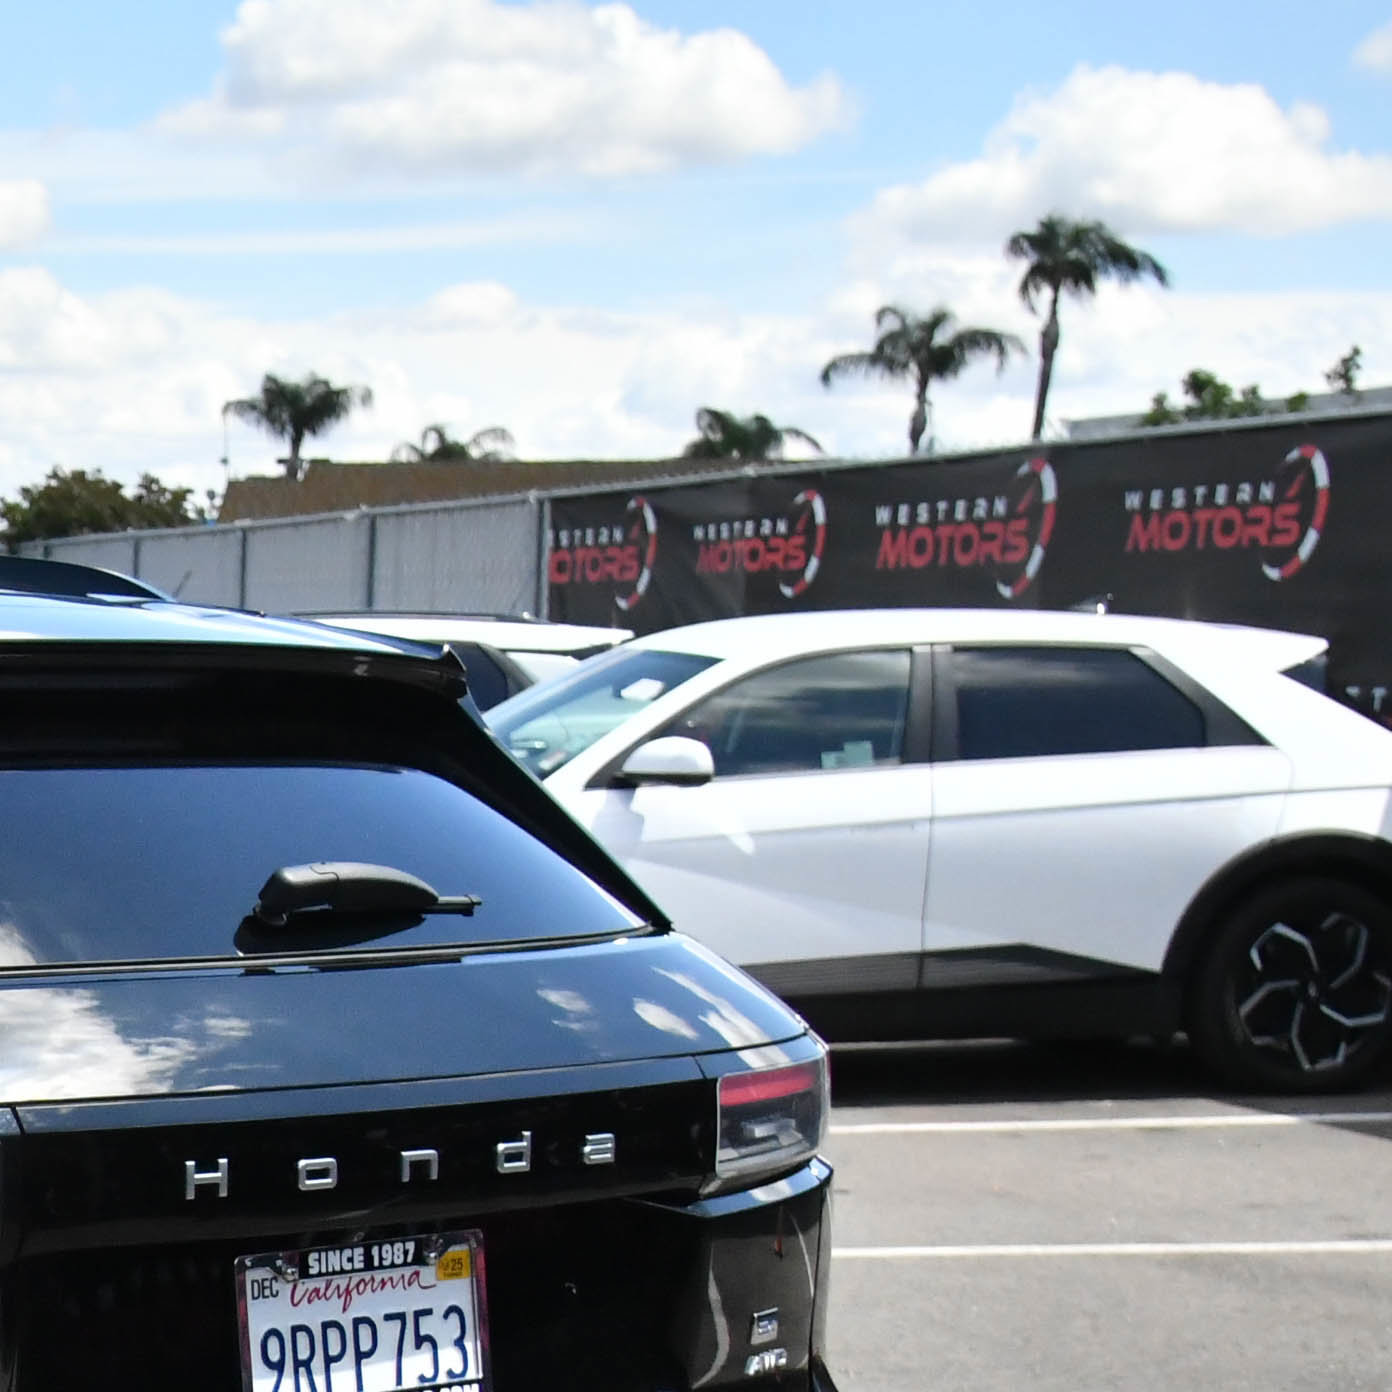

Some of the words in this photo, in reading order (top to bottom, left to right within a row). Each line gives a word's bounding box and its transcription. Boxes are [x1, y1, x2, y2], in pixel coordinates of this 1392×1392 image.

[876, 496, 1007, 526] WESTERN
[1125, 482, 1274, 510] WESTERN
[876, 517, 1029, 568] MOTORS
[1125, 502, 1300, 552] MOTORS
[185, 1131, 615, 1200] Honda
[308, 1248, 364, 1275] SINCE
[371, 1241, 415, 1267] 1987
[251, 1276, 279, 1300] DEC
[290, 1269, 436, 1314] California
